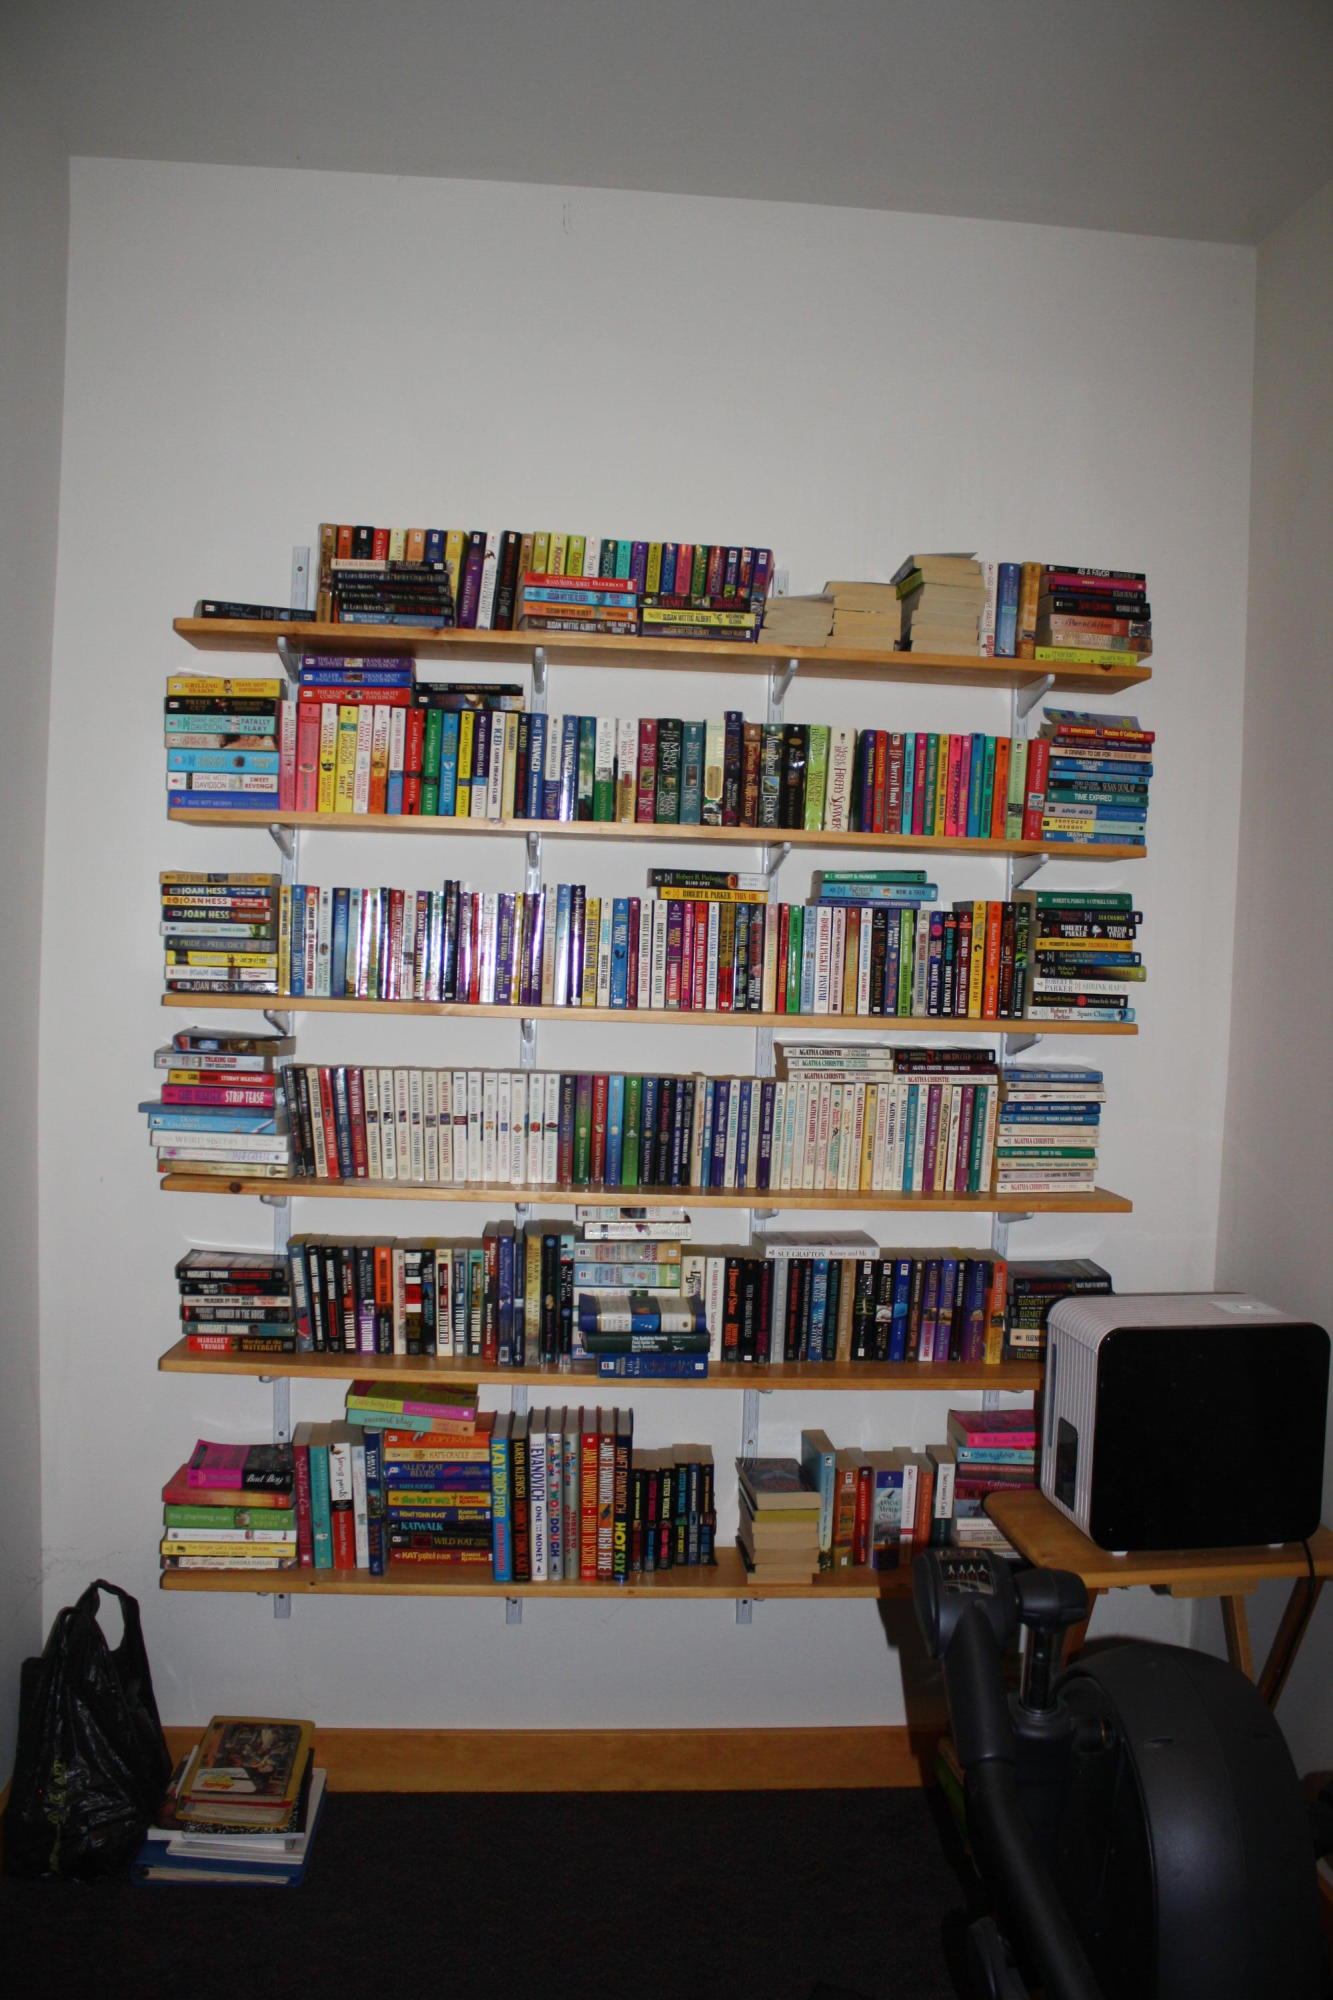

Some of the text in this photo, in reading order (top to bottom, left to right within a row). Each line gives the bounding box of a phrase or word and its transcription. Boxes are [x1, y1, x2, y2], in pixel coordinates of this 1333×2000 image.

[1092, 569, 1110, 577] FAVOR
[379, 721, 387, 761] CHOPPING
[494, 728, 502, 746] ICED
[531, 735, 542, 772] TWANGED
[565, 739, 575, 776] TWANGED
[669, 742, 679, 769] MAEVE
[889, 761, 902, 807] Sherryl Woods
[1074, 793, 1087, 801] TIME
[763, 795, 777, 823] ECHOES
[831, 768, 846, 830] FIREFLY SUMMER
[182, 887, 204, 895] JOAN
[683, 890, 731, 899] ROBERT PARKER
[182, 910, 230, 919] JOAN HESS
[338, 904, 346, 922] JOAN
[819, 948, 828, 973] PARKER
[192, 982, 229, 992] JOAN HESS
[818, 975, 827, 1001] PASTIME
[802, 1059, 821, 1067] AGATHA
[908, 1075, 928, 1083] AGATHA
[225, 1090, 244, 1103] STRIP
[245, 1091, 264, 1103] TEASE
[808, 1120, 816, 1142] CHRISTIE
[820, 1119, 828, 1140] CHRISTIE
[855, 1117, 863, 1139] CHRISTIE
[728, 1268, 739, 1290] Houses
[819, 1274, 827, 1301] BARBARA
[929, 1271, 937, 1291] ELIZABETH
[974, 1272, 984, 1307] ELIZABETH PETERS
[727, 1298, 737, 1315] Stone
[344, 1315, 355, 1349] TRUMAN
[361, 1320, 374, 1351] TRUMAN
[439, 1311, 449, 1344] TRUMAN
[455, 1309, 464, 1342] TRUMAN
[471, 1310, 481, 1342] TRUMAN
[492, 1443, 507, 1470] KAT
[514, 1441, 526, 1498] KAREN KIJEWSKI
[531, 1448, 545, 1501] EVANOVICH
[599, 1443, 613, 1504] JANET EVANOVICH
[582, 1447, 597, 1567] JANET EVANOVICH FOUR TO SCORE
[614, 1447, 628, 1573] JANET EVANOVICH HOT SIX
[400, 1522, 444, 1531] KATWALK
[551, 1518, 560, 1557] DOUGH
[434, 1537, 474, 1545] WILD KAT
[535, 1533, 543, 1563] MONEY
[571, 1536, 577, 1549] TO
[598, 1527, 612, 1570] HIGH FIVE
